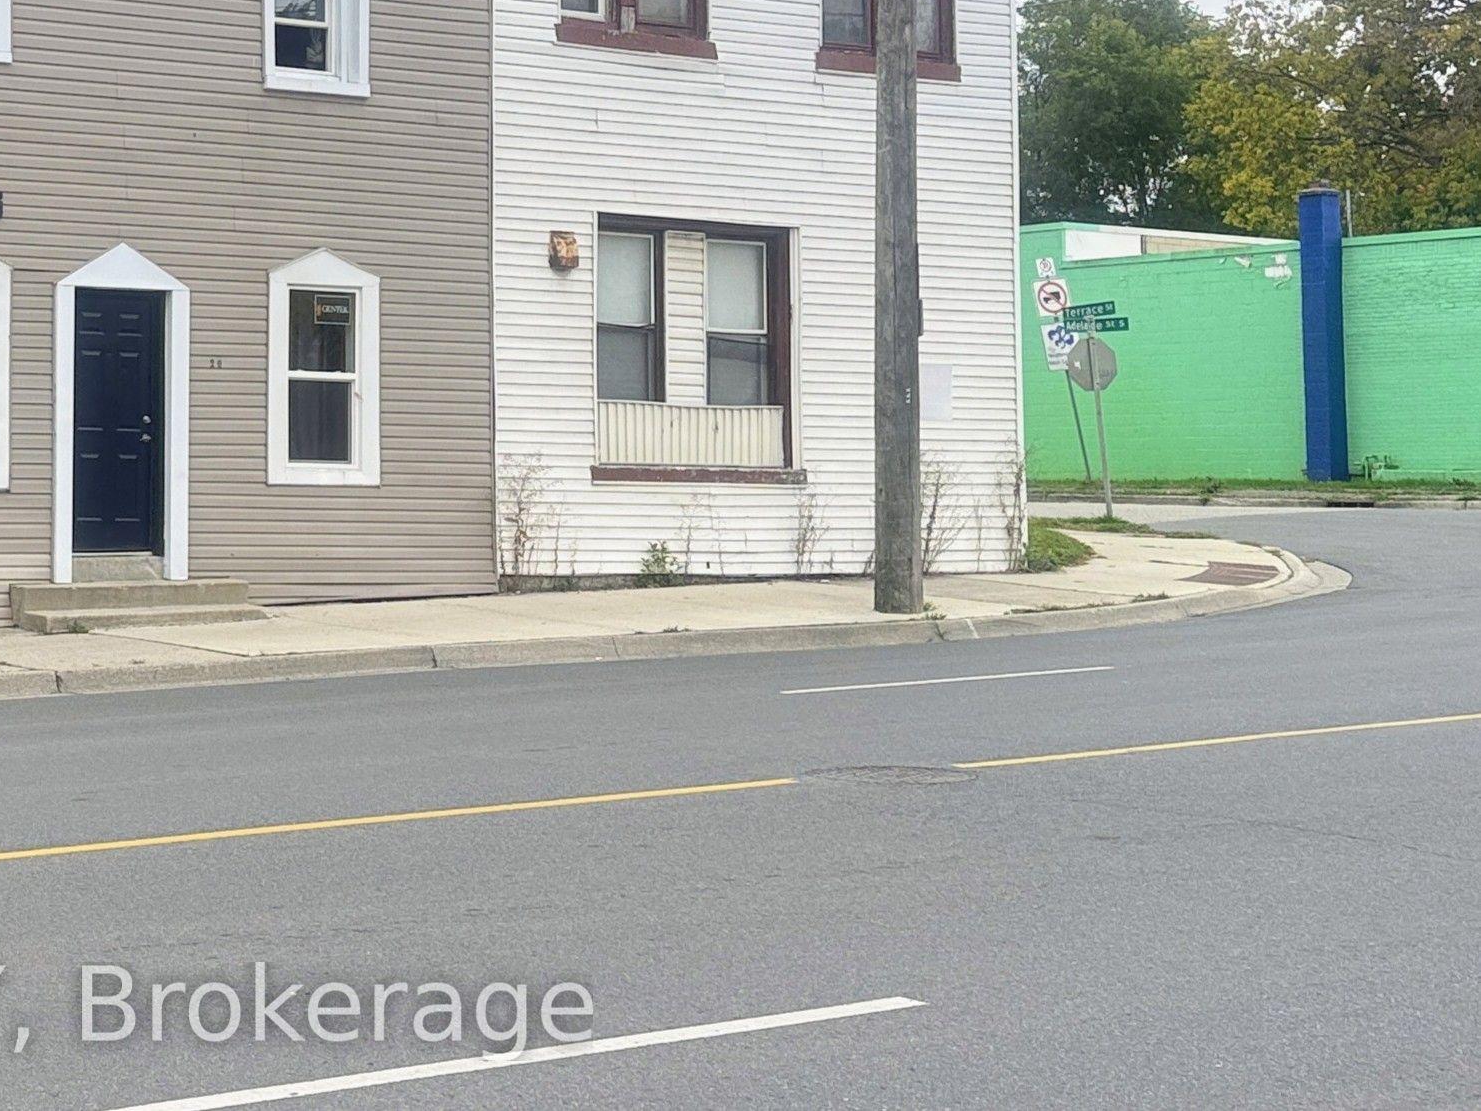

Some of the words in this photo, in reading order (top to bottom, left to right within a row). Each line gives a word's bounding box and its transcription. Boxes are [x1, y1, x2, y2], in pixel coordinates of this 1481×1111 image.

[1065, 305, 1104, 317] Terrace
[1105, 303, 1113, 311] St
[1065, 320, 1103, 331] Adelaide
[1105, 320, 1115, 328] St
